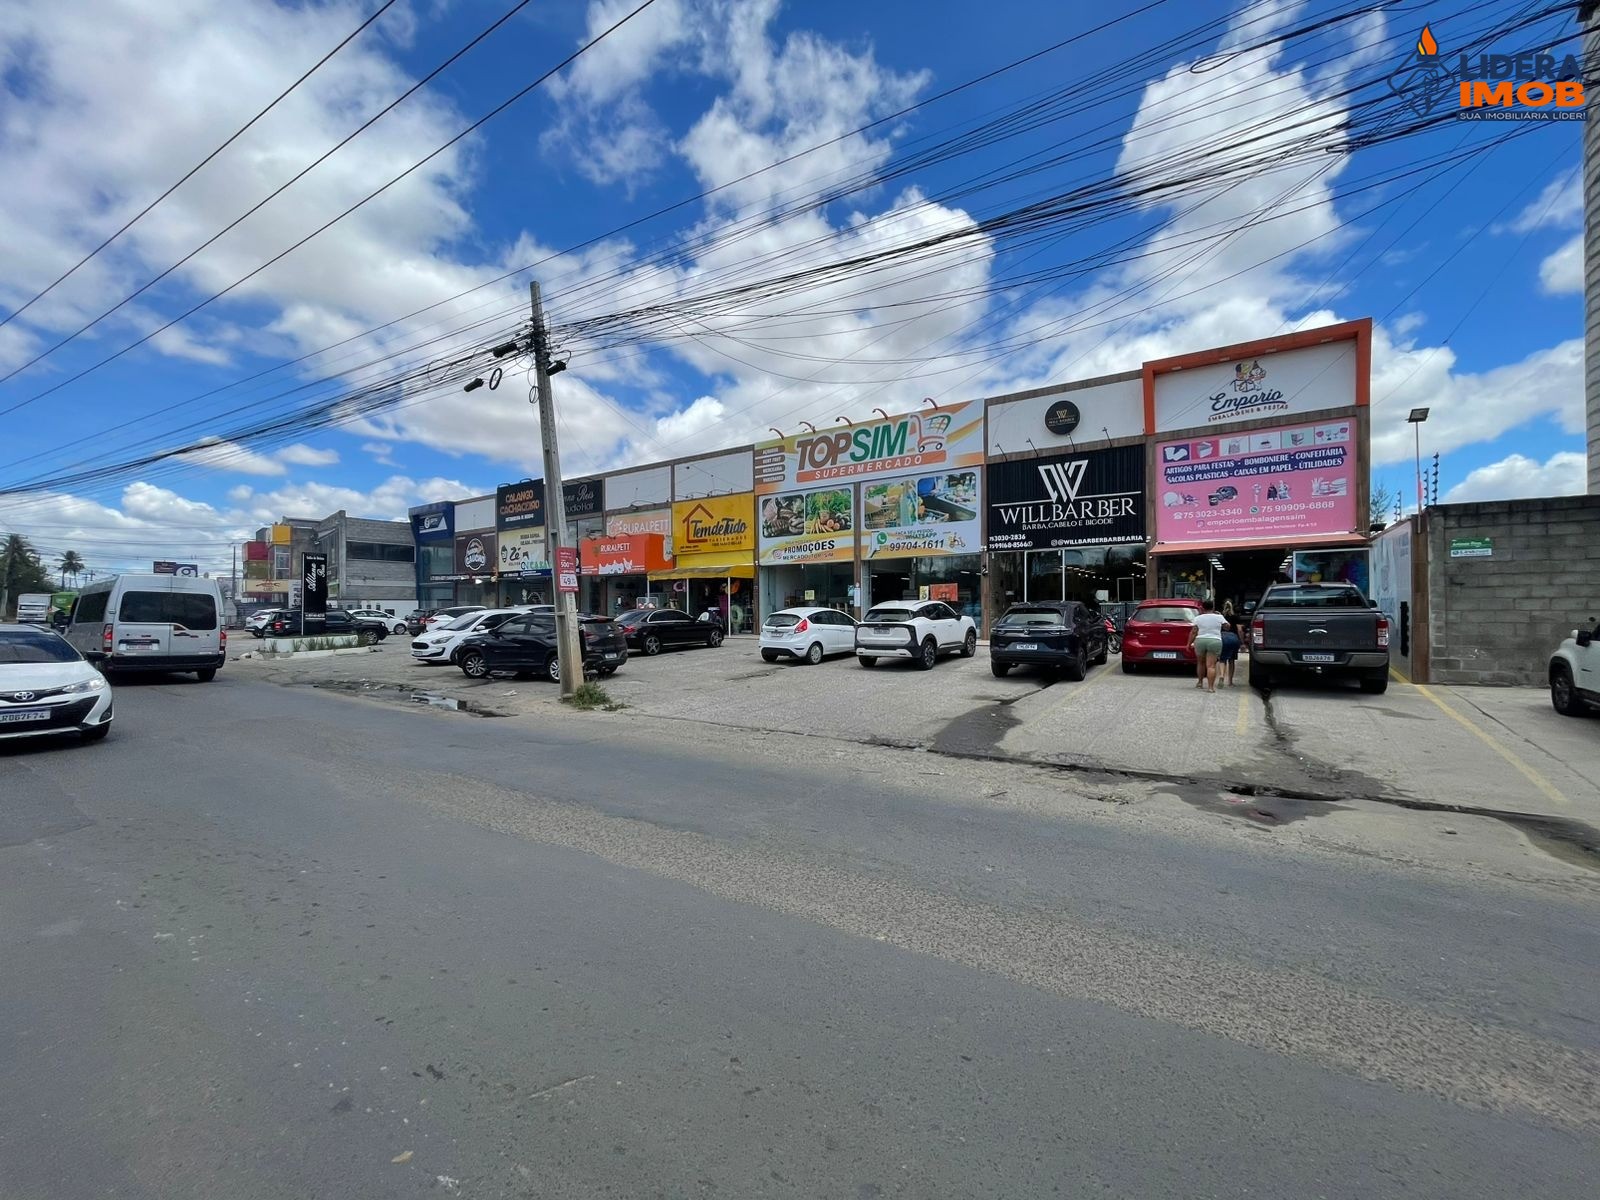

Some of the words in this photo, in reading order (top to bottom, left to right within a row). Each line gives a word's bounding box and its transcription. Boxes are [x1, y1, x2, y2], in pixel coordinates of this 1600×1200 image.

[1208, 408, 1254, 422] EMBALAGENS
[815, 455, 923, 480] SUPERMERCADO
[1166, 465, 1192, 475] ARTIGOS
[1193, 463, 1210, 472] PARA
[1211, 460, 1235, 469] FESTAS
[1244, 453, 1289, 466] BOMBONIERE
[1167, 474, 1194, 483] SACOLAS
[1234, 467, 1257, 477] CAIXAS
[1260, 465, 1269, 474] EM
[1270, 463, 1292, 472] PAPEL
[505, 490, 534, 503] CALANGO
[1183, 511, 1193, 519] 75
[1196, 507, 1243, 518] 3023-3340
[1261, 505, 1273, 513] 75
[1086, 518, 1114, 526] BIGODE
[600, 542, 631, 552] RURALPETT
[889, 539, 945, 552] 99704-1611
